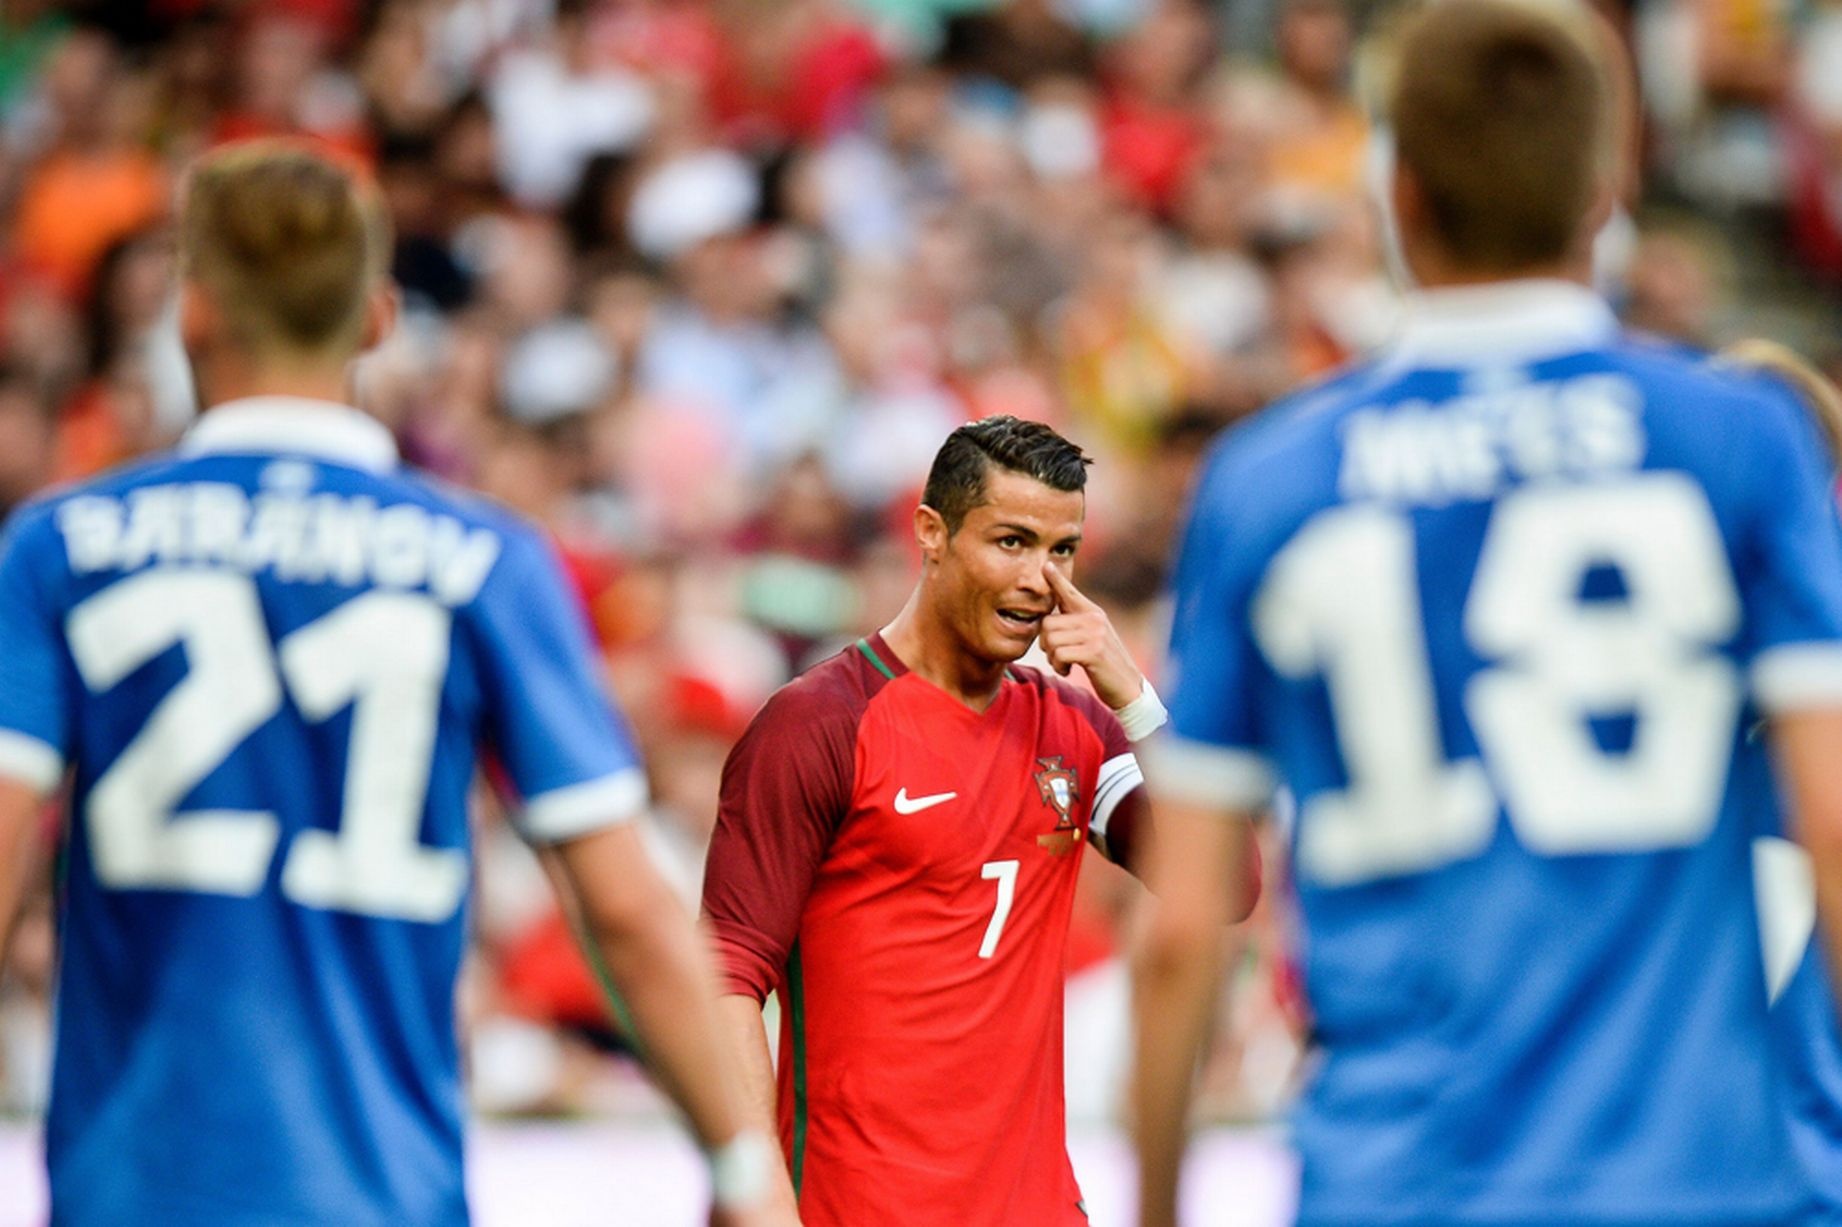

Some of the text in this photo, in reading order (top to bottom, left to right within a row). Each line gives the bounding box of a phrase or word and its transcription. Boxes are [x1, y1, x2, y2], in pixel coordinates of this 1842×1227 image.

[66, 563, 470, 922] 21
[1252, 472, 1742, 888] 18
[979, 860, 1020, 959] 7
